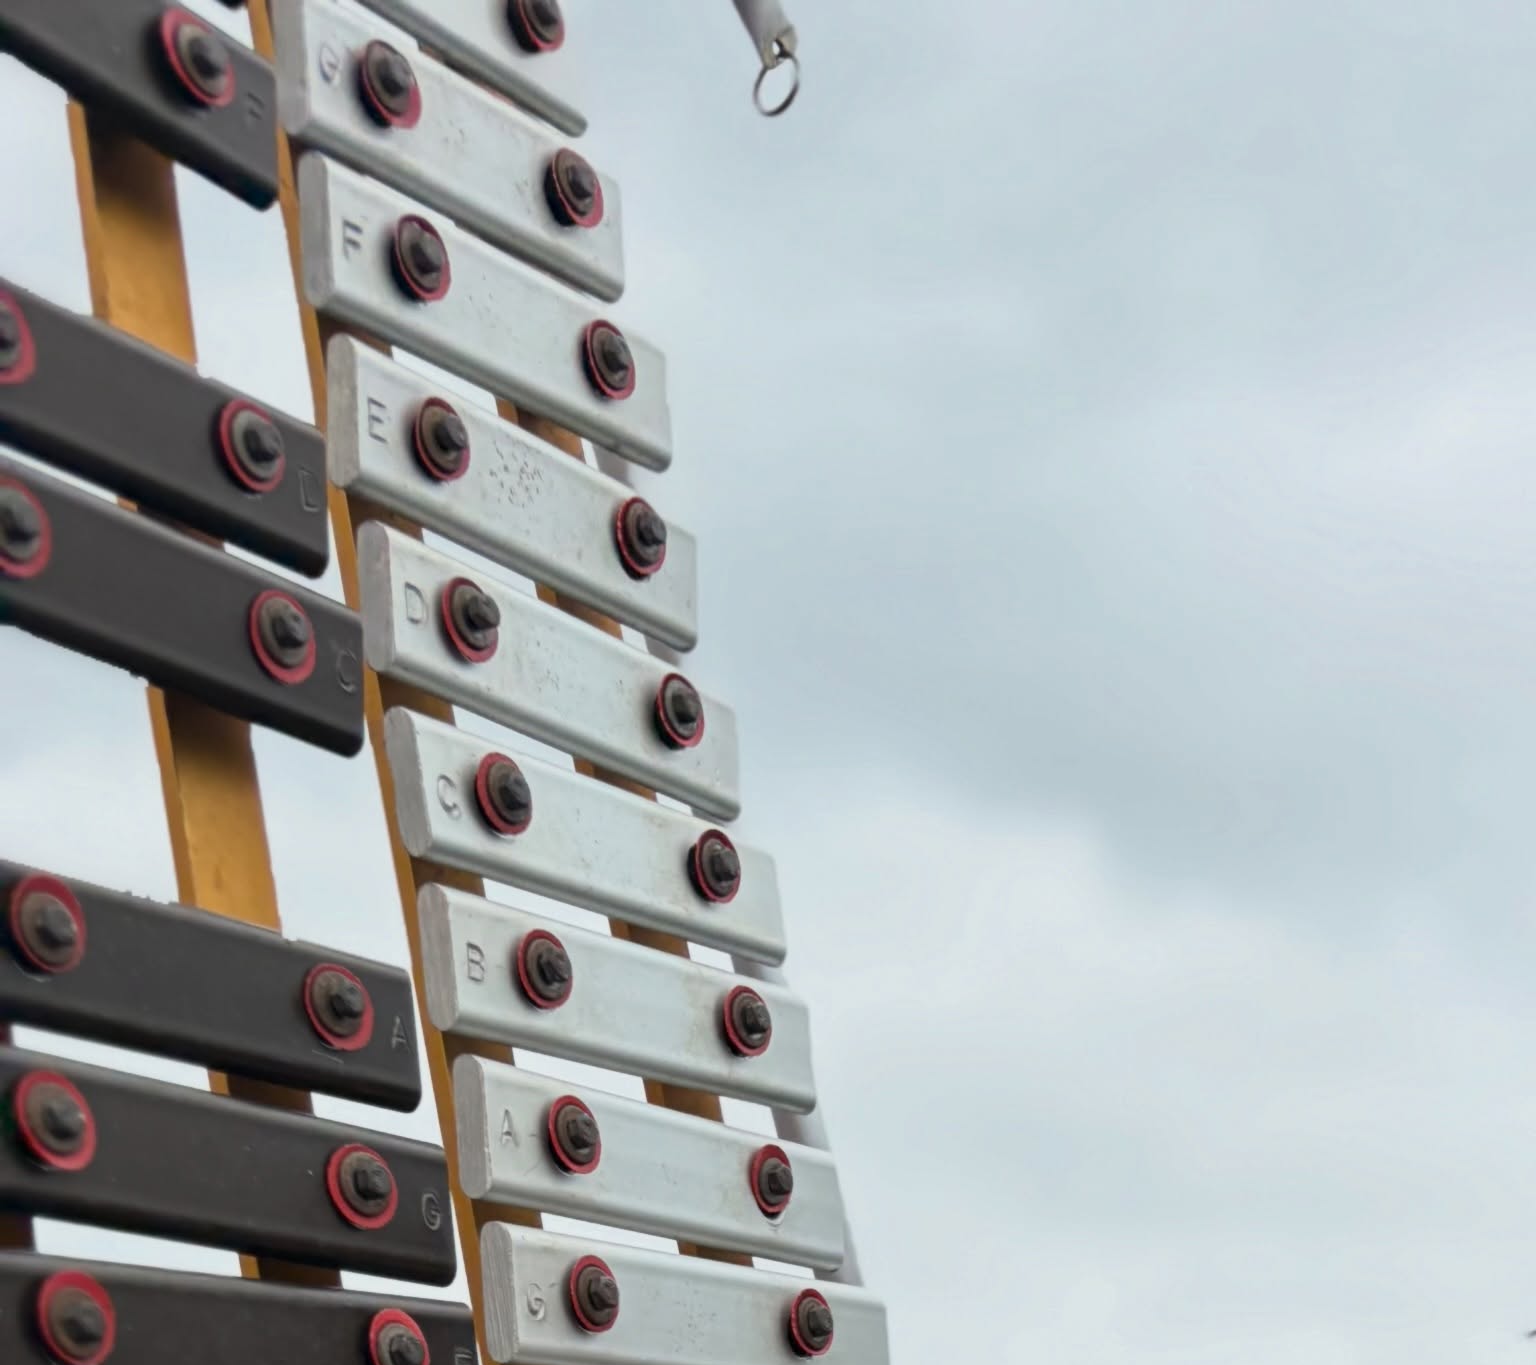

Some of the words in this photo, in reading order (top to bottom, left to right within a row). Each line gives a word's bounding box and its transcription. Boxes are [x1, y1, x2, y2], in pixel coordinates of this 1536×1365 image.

[342, 219, 364, 261] F
[366, 397, 388, 443] E
[404, 581, 428, 624] D
[437, 774, 461, 820] C
[466, 941, 485, 983] B
[391, 1015, 413, 1055] A
[499, 1108, 520, 1147] A
[421, 1191, 440, 1231] G
[526, 1282, 545, 1321] G
